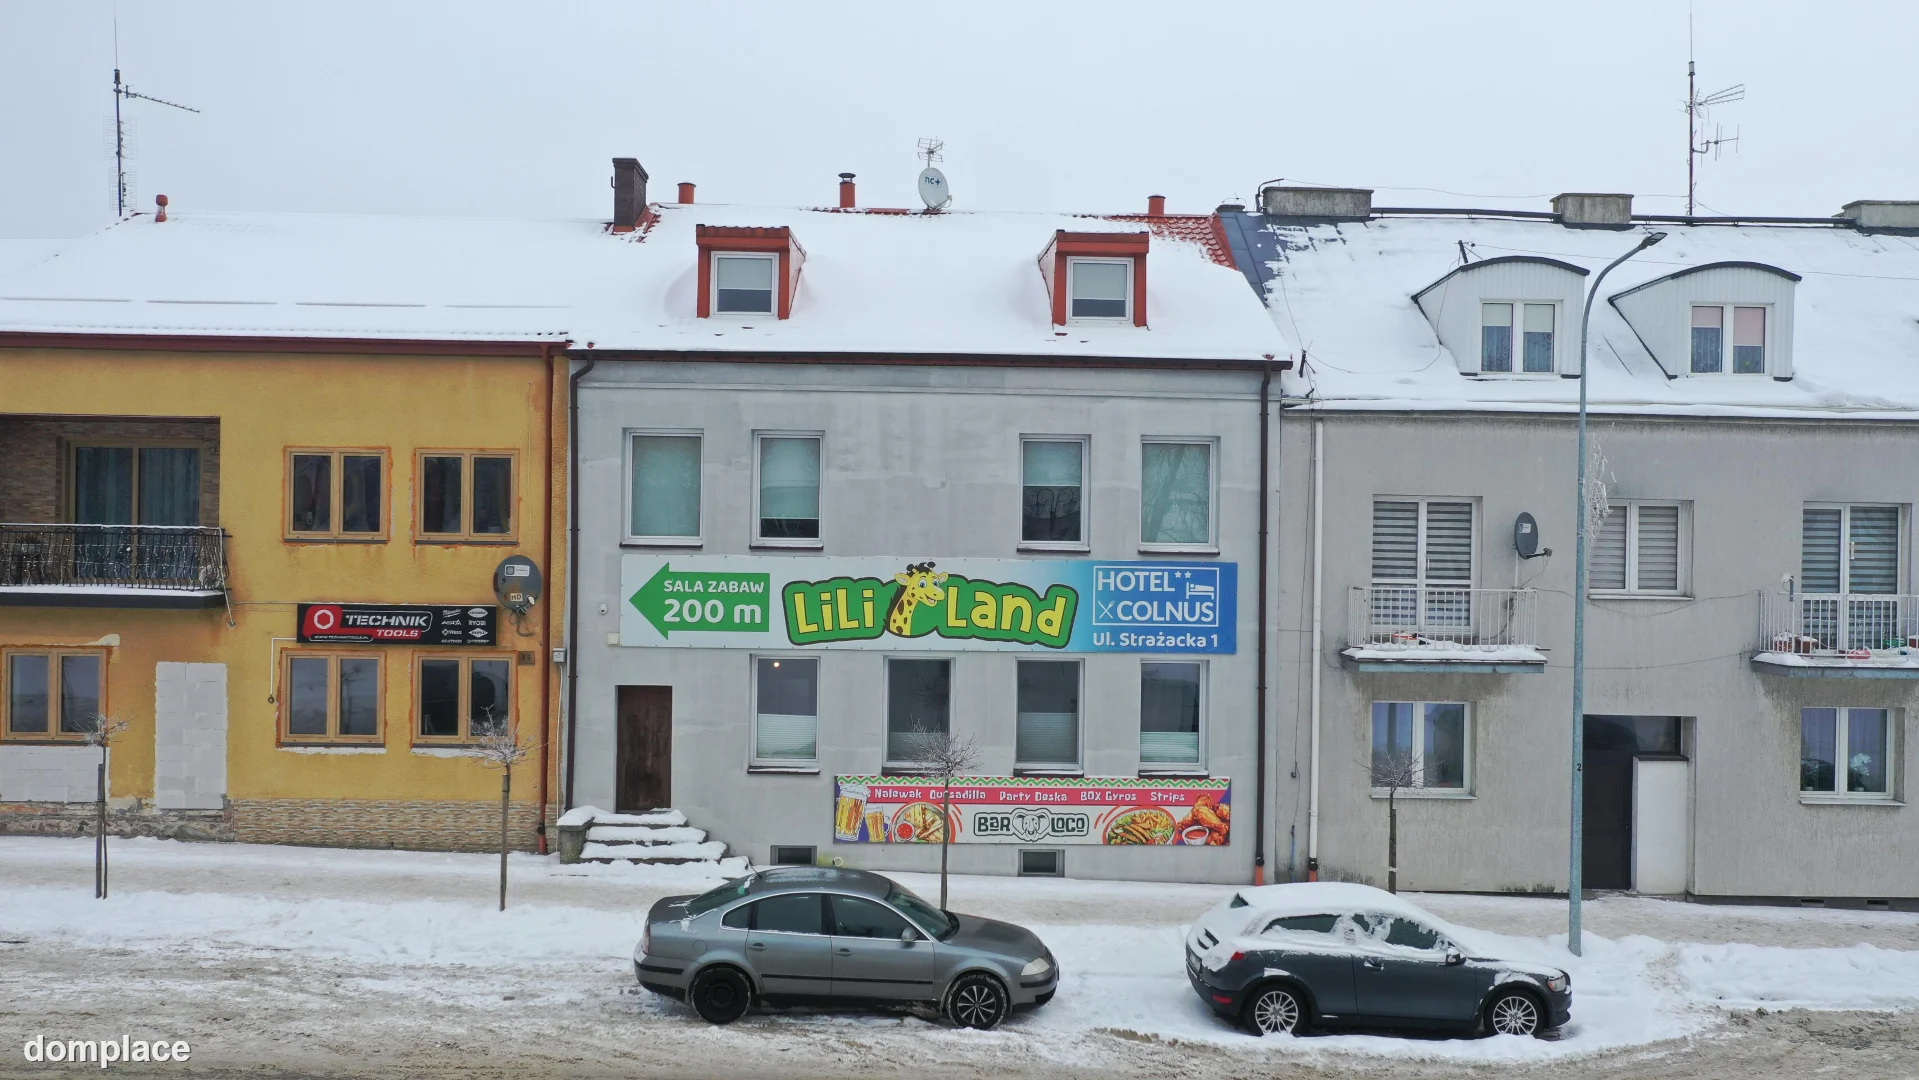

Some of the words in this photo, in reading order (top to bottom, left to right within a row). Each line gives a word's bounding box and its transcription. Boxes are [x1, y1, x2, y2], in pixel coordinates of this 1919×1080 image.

[924, 176, 941, 186] nc+
[664, 580, 704, 592] SALA
[707, 580, 764, 593] ZABAW
[1097, 571, 1176, 592] HOTEL
[663, 598, 724, 623] 200
[733, 603, 762, 624] m
[947, 586, 1067, 637] Land
[1116, 600, 1214, 622] COLNUS
[345, 614, 427, 627] TECHNIK
[376, 629, 419, 637] TOOLS
[1119, 632, 1206, 648] Strażacka
[1210, 634, 1219, 648] 1
[1576, 763, 1582, 771] 2
[874, 788, 922, 799] Nalewak
[999, 792, 1031, 801] Party
[1034, 792, 1068, 802] Deska
[1080, 792, 1102, 801] BOX
[1105, 791, 1137, 802] Gyros
[1150, 792, 1185, 803] Strips
